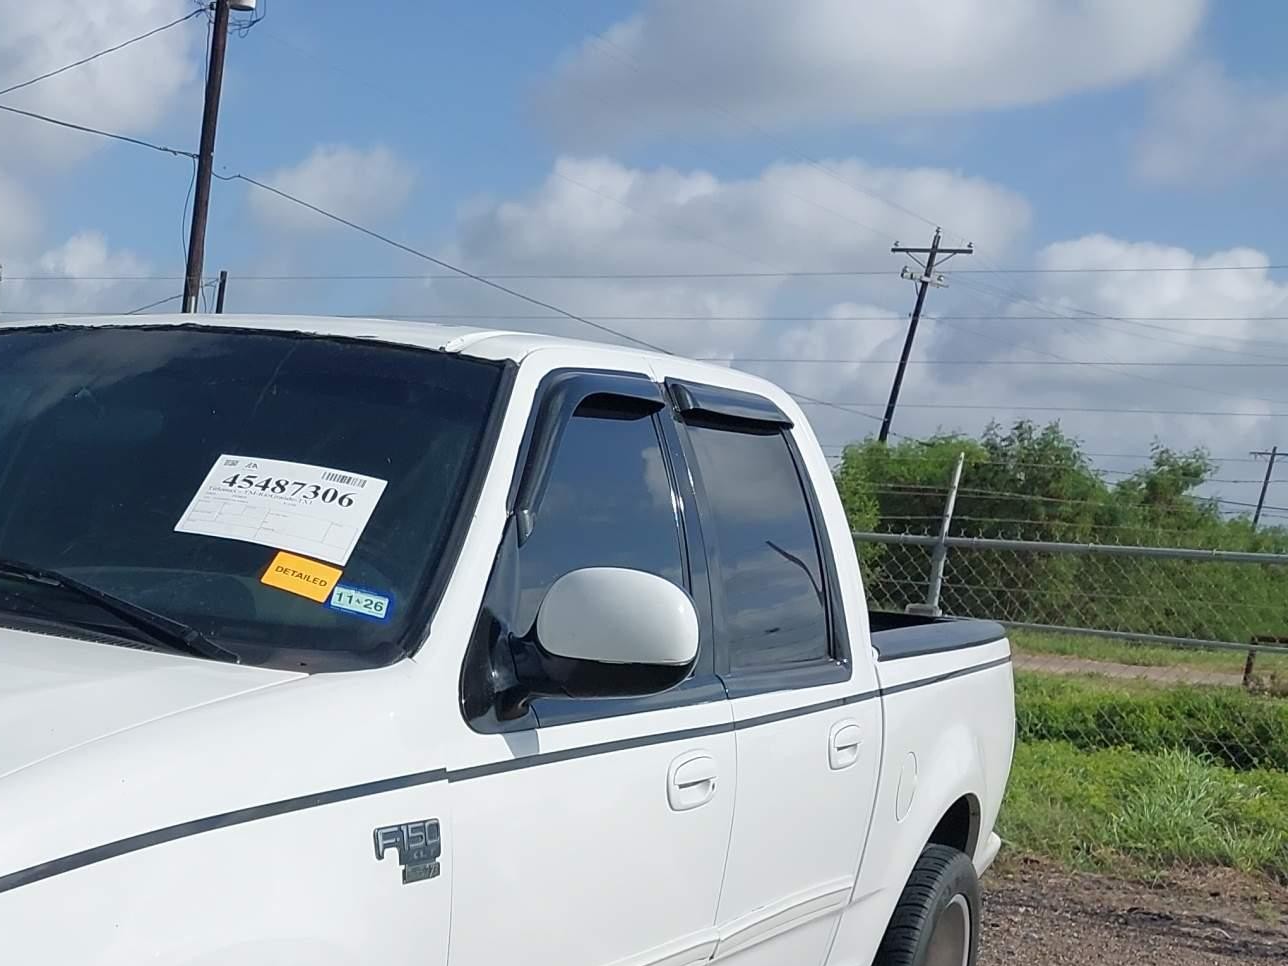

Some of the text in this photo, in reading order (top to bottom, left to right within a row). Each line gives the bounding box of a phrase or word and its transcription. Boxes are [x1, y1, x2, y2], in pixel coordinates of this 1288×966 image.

[222, 473, 357, 508] 45487306
[274, 564, 328, 588] DETAILED
[362, 597, 384, 612] 26
